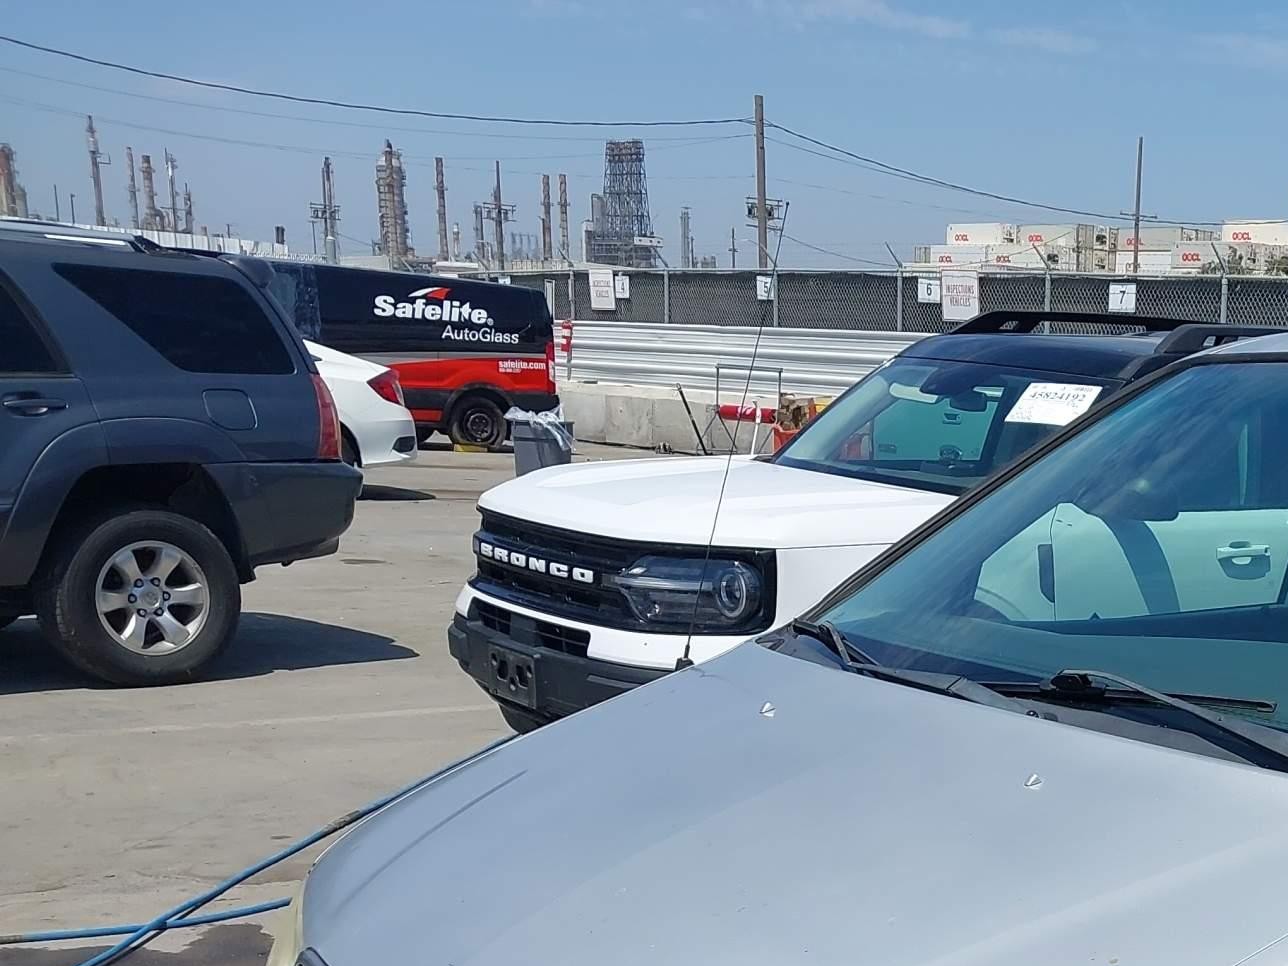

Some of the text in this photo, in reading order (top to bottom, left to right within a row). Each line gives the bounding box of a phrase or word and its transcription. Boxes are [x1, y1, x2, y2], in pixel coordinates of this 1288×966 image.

[954, 233, 969, 242] OOCL
[1232, 231, 1252, 241] OOCL
[1182, 252, 1201, 262] OOCL
[763, 281, 769, 294] 5
[926, 283, 933, 296] 6
[1119, 290, 1127, 304] 7
[442, 325, 519, 344] AutoGlass
[498, 360, 546, 370] safelite.com
[480, 542, 594, 584] BRONCO
